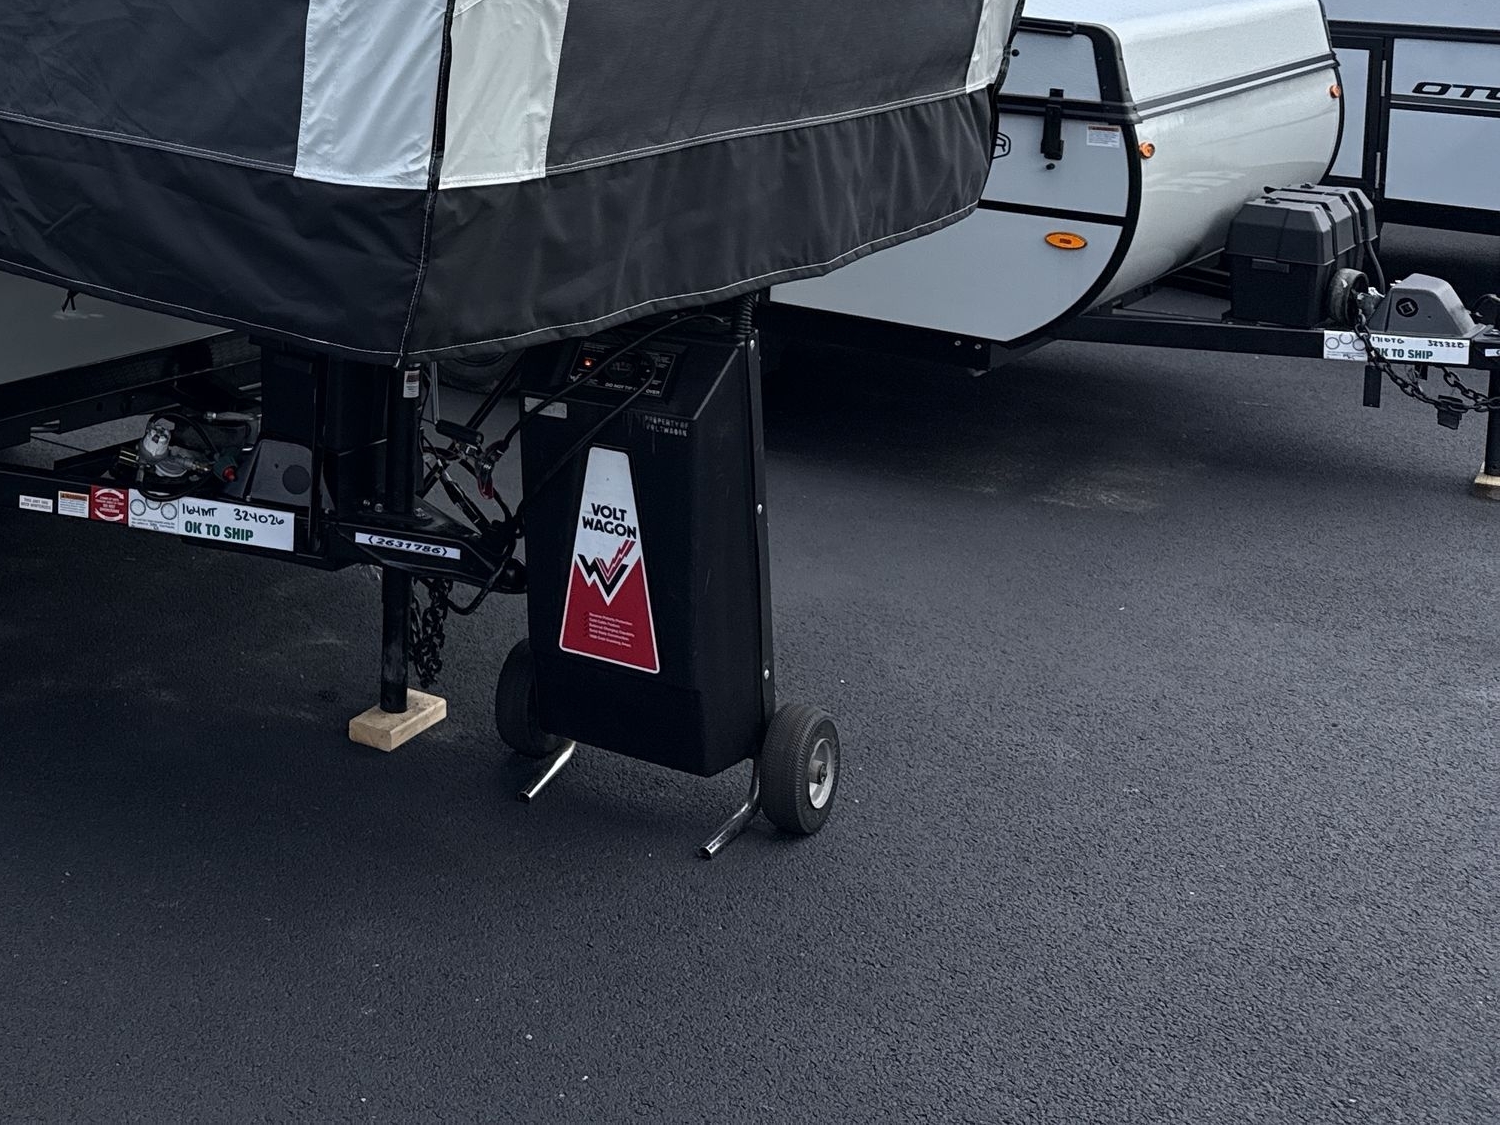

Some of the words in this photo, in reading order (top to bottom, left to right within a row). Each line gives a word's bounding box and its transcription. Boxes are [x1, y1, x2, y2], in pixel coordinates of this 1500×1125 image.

[1391, 348, 1404, 358] TO
[1407, 349, 1433, 360] SHIP
[644, 415, 679, 428] PROPERTY
[182, 503, 218, 517] 164MT
[233, 508, 284, 525] 324026
[591, 502, 627, 522] VOLT
[184, 520, 202, 535] OK
[205, 523, 220, 537] TO
[223, 526, 254, 541] SHIP
[582, 516, 637, 539] WAGON
